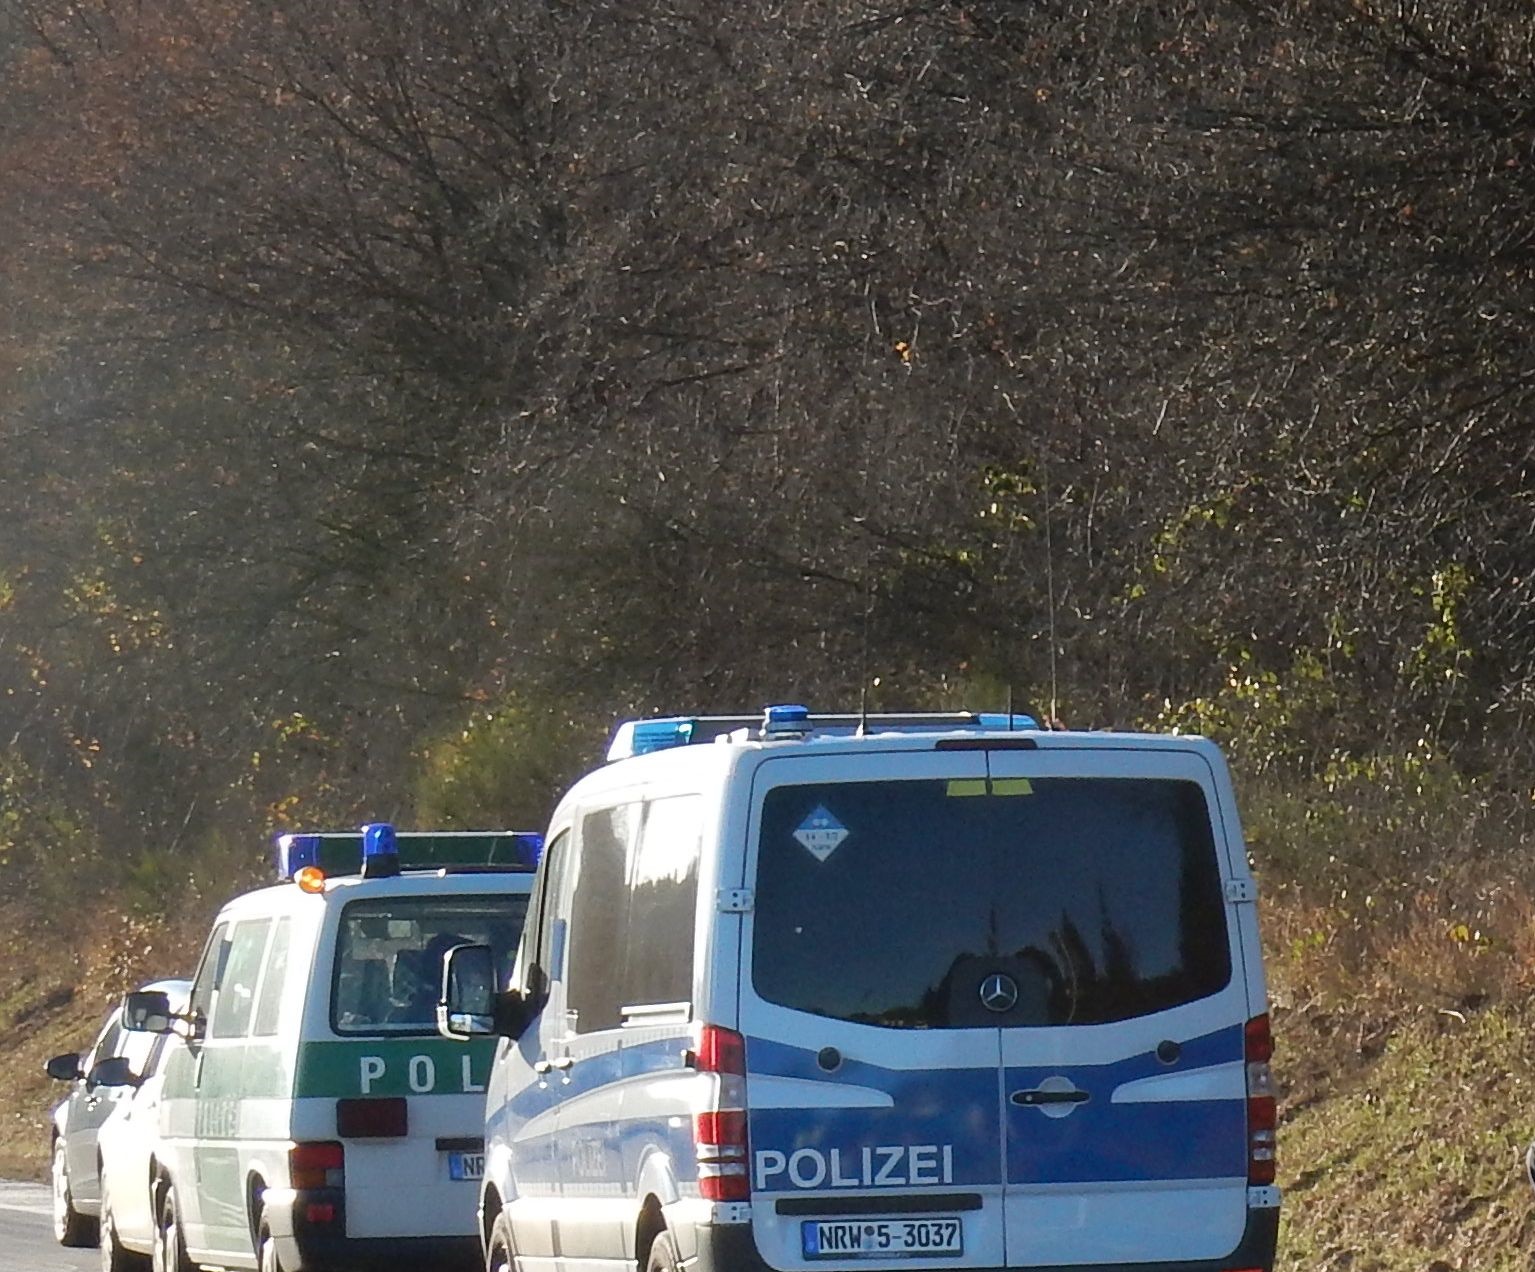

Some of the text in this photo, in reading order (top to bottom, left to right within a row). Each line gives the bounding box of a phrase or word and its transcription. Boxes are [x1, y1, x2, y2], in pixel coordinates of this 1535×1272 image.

[360, 1054, 485, 1094] POL
[463, 1157, 485, 1176] NR
[756, 1145, 953, 1189] POLIZEI
[819, 1222, 958, 1250] NRW 5-3037
